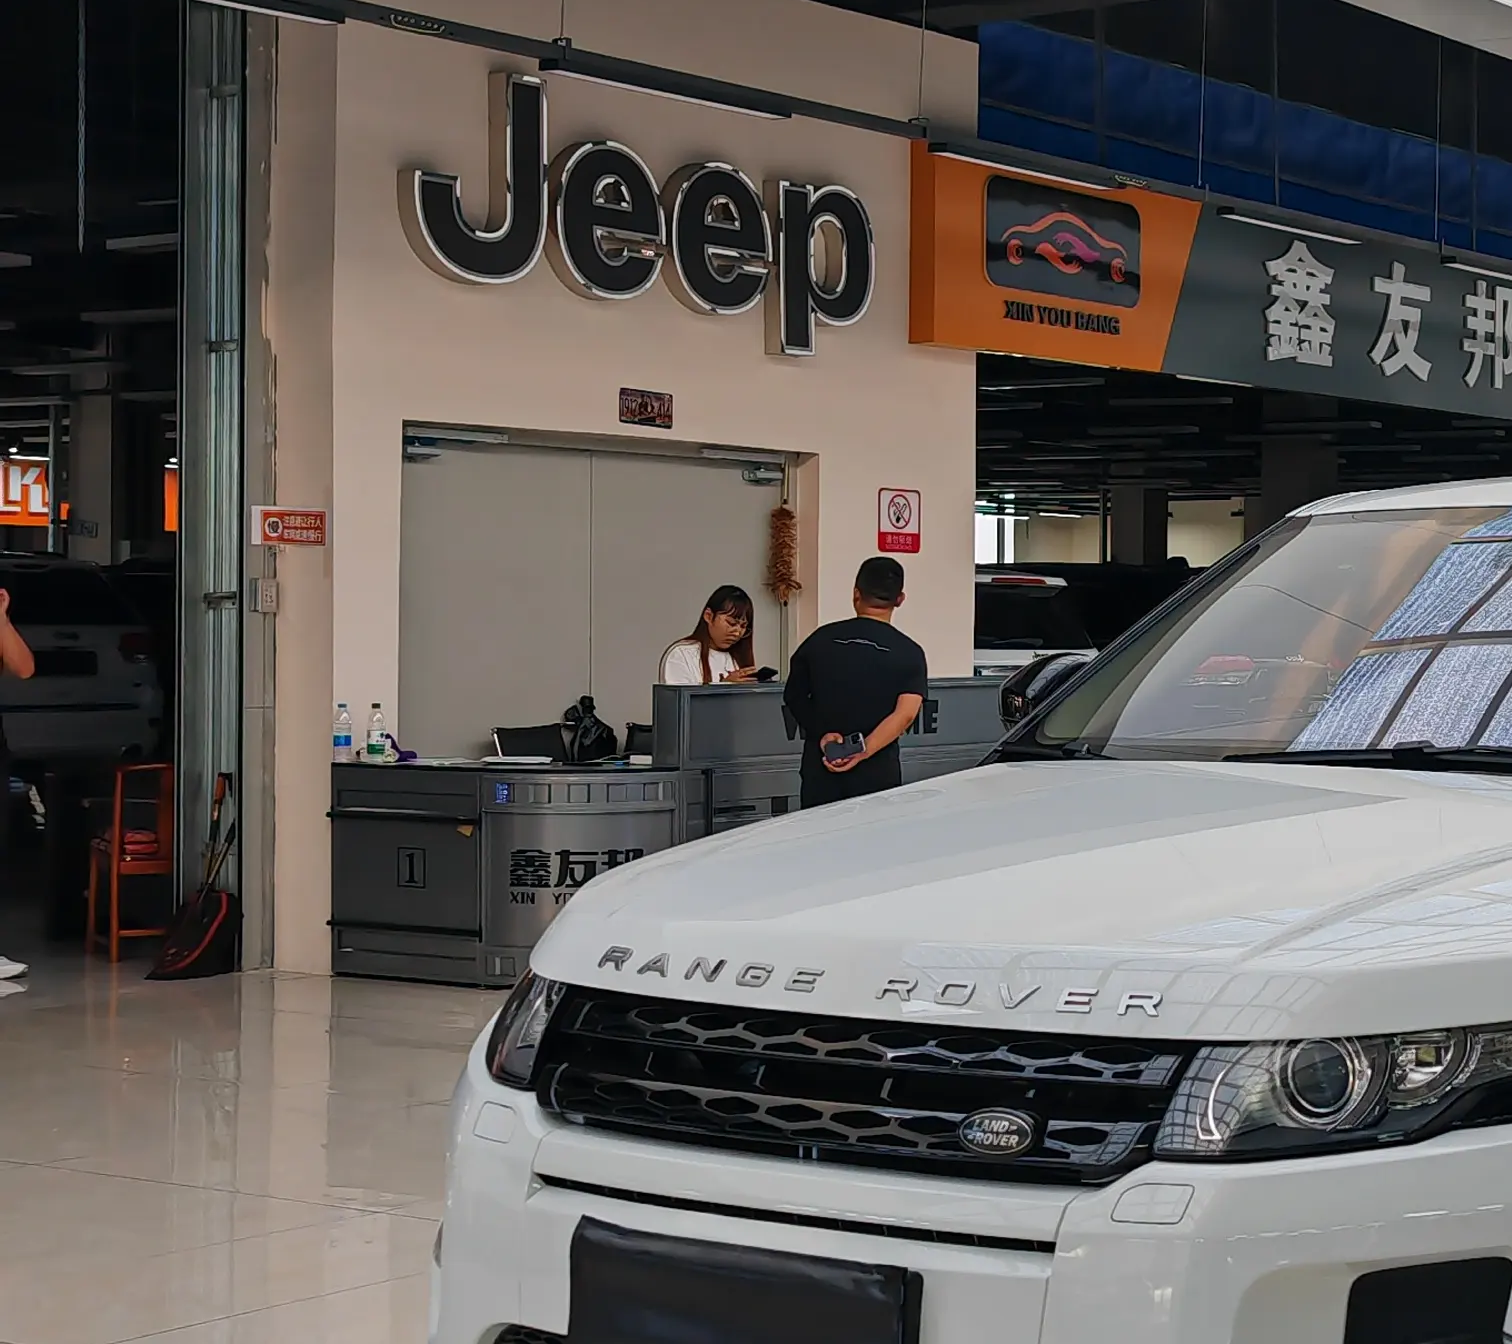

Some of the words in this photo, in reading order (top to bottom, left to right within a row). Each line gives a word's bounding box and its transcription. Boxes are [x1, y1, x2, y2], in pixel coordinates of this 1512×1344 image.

[397, 72, 876, 357] Jeep
[1004, 299, 1034, 323] XIN
[1036, 305, 1071, 329] YOU
[1075, 312, 1121, 336] BANG
[404, 852, 418, 884] 1
[509, 891, 536, 905] XIN
[597, 945, 825, 993] RANGE
[875, 976, 1164, 1017] ROVER
[972, 1118, 1010, 1133] LAND
[973, 1131, 1020, 1148] ROVER
